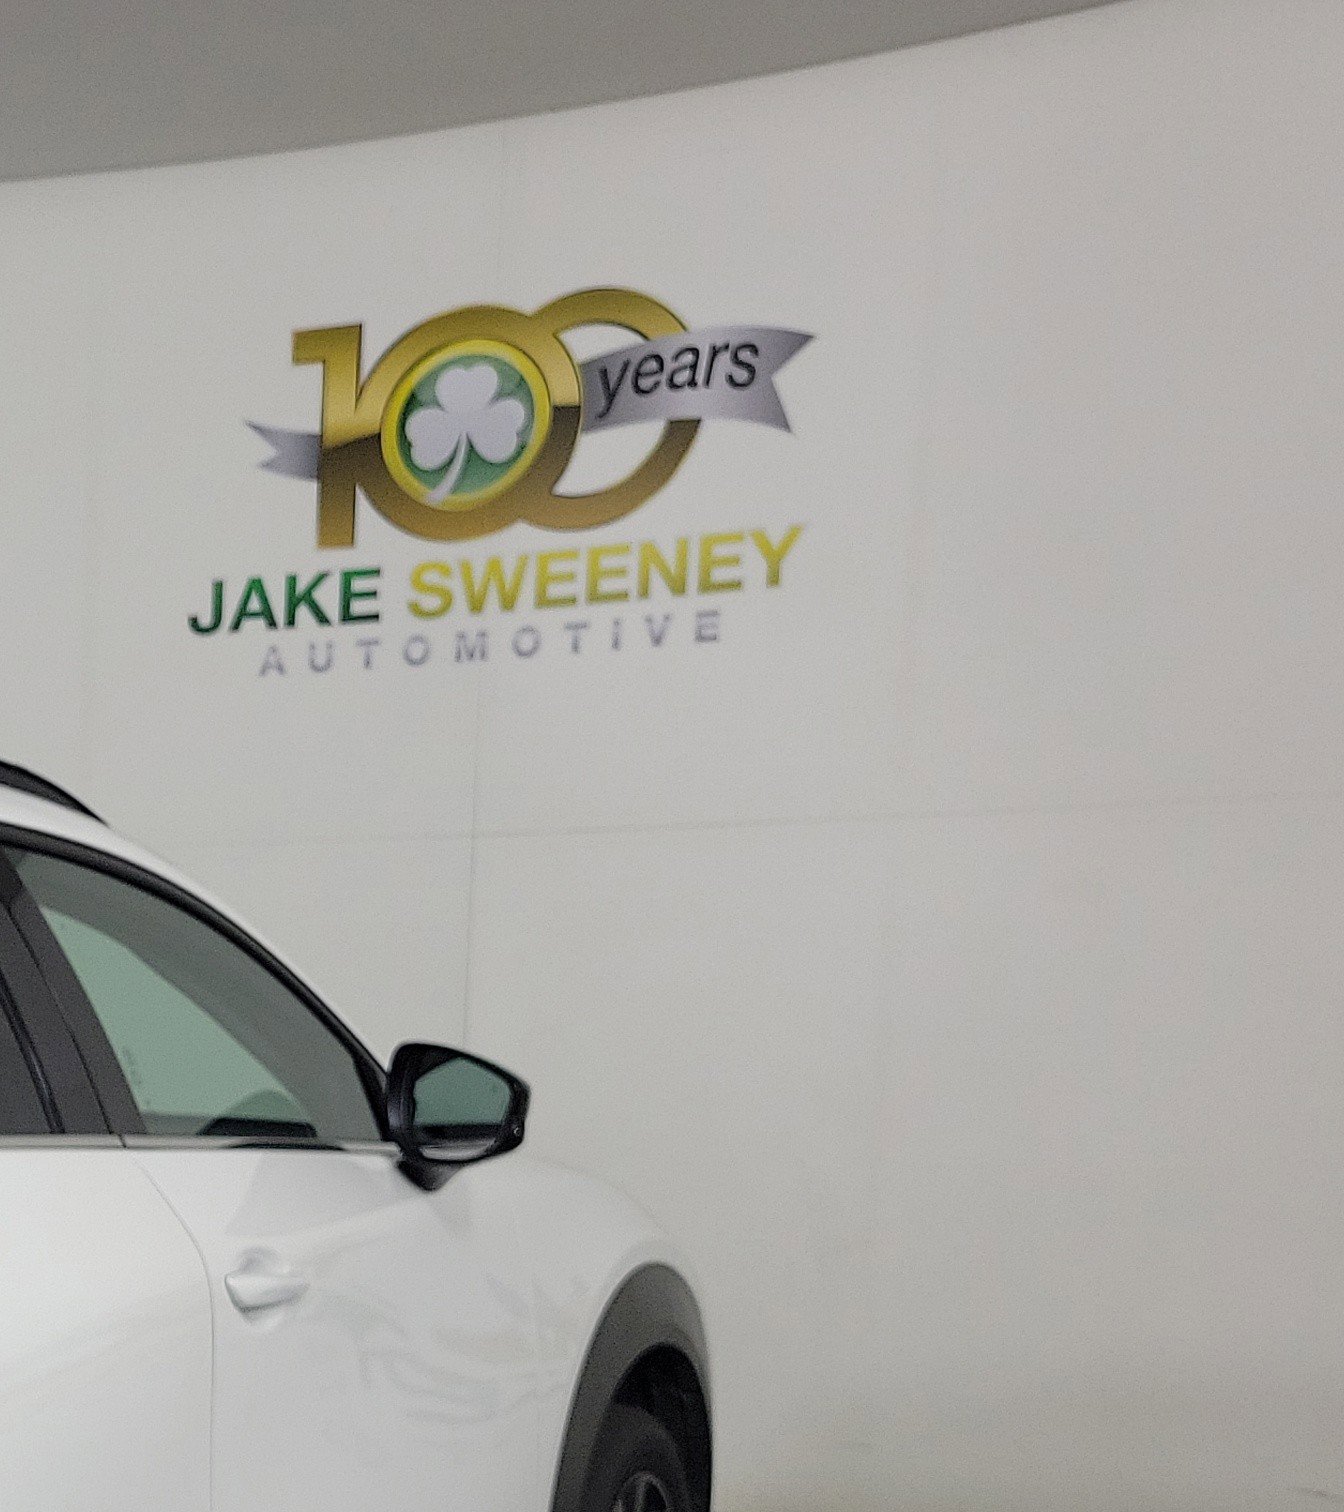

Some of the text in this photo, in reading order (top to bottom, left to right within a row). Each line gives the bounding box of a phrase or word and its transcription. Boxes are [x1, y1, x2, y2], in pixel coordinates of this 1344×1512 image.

[291, 286, 702, 551] 100
[596, 341, 759, 419] years
[187, 525, 803, 637] JAKE SWEENEY
[258, 610, 721, 678] AUTOMOTIVE
